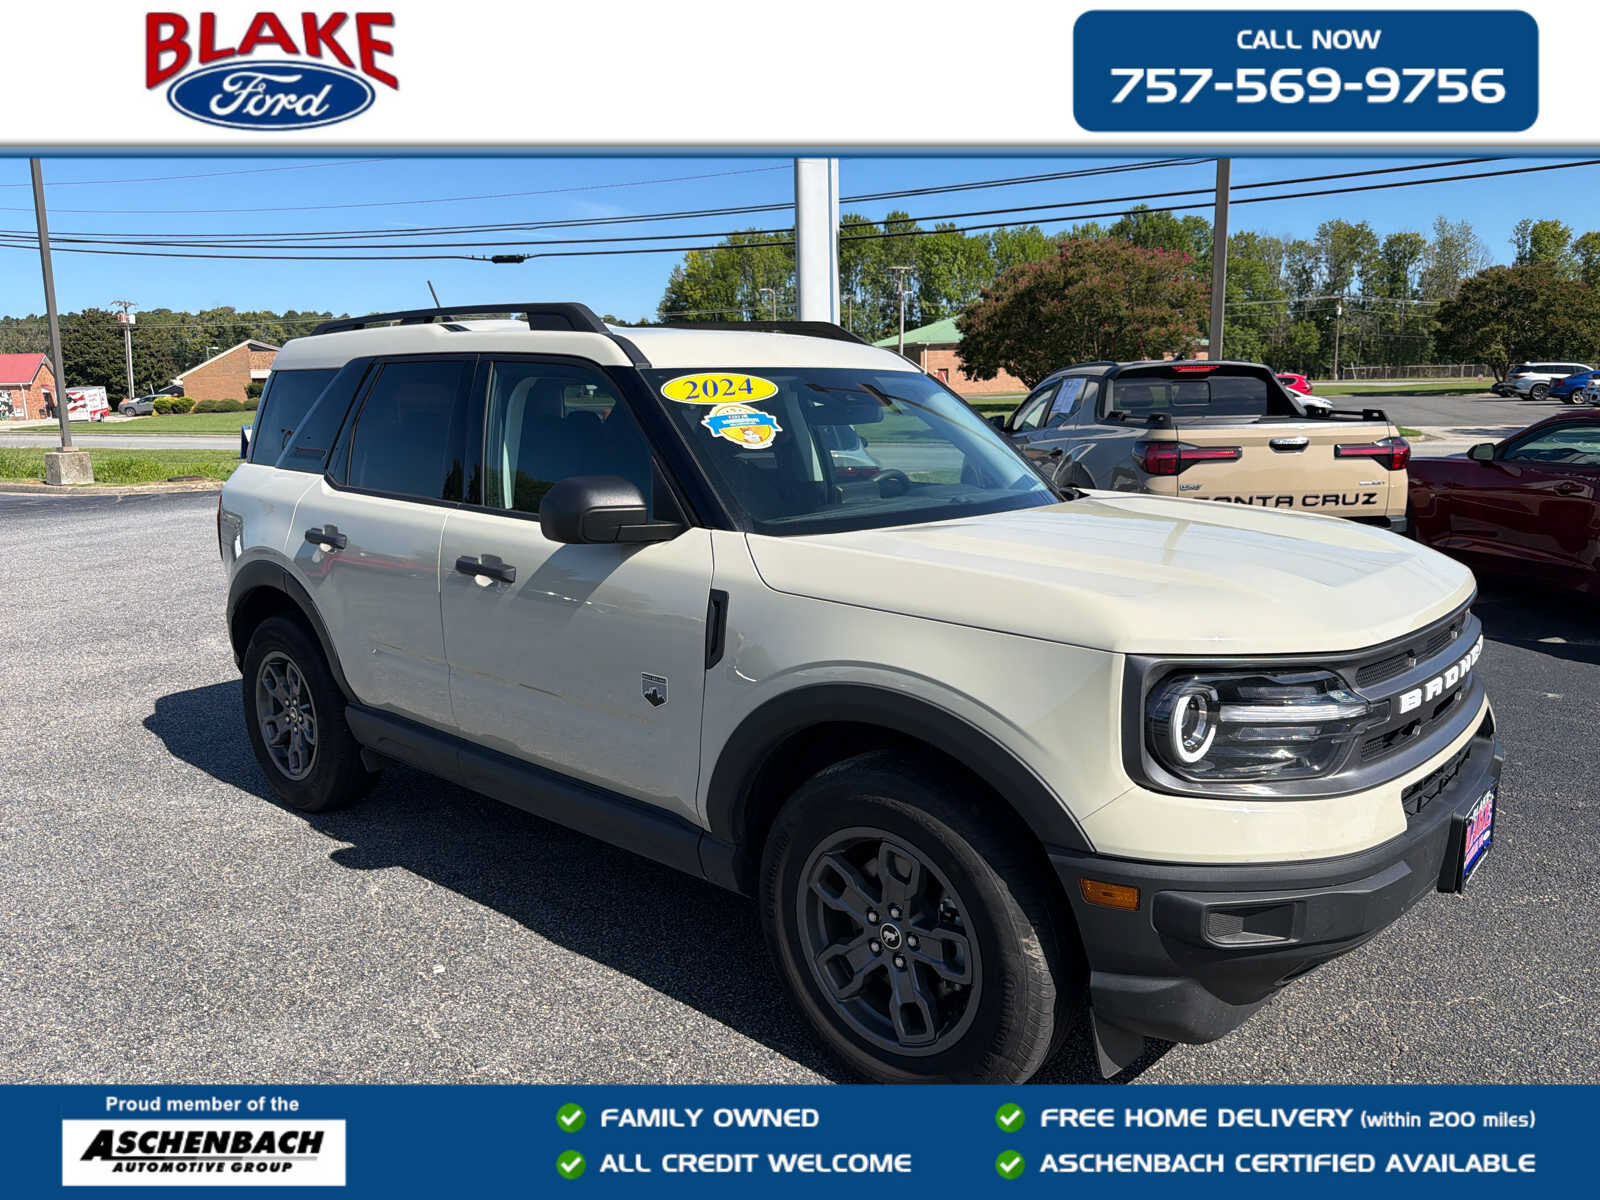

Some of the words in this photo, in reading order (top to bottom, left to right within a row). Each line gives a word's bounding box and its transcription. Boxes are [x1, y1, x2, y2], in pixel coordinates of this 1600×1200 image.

[683, 377, 754, 399] 2024
[1193, 495, 1294, 507] NTA
[1301, 493, 1378, 506] CRUZ
